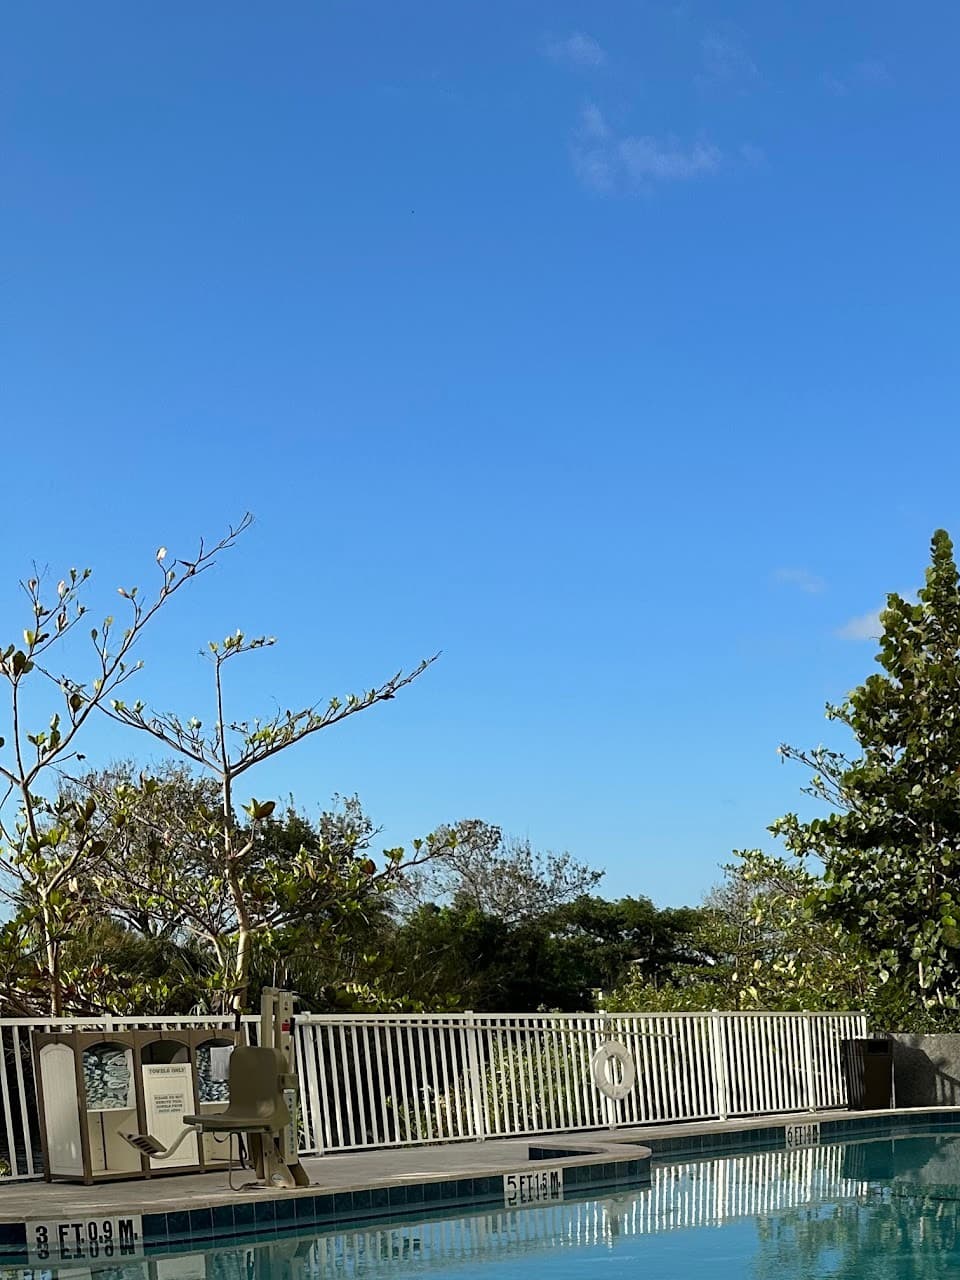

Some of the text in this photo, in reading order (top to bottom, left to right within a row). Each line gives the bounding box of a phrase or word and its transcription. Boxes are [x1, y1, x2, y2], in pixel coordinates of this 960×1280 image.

[35, 1225, 48, 1243] 3
[88, 1220, 113, 1242] 0.9
[118, 1219, 138, 1242] M.
